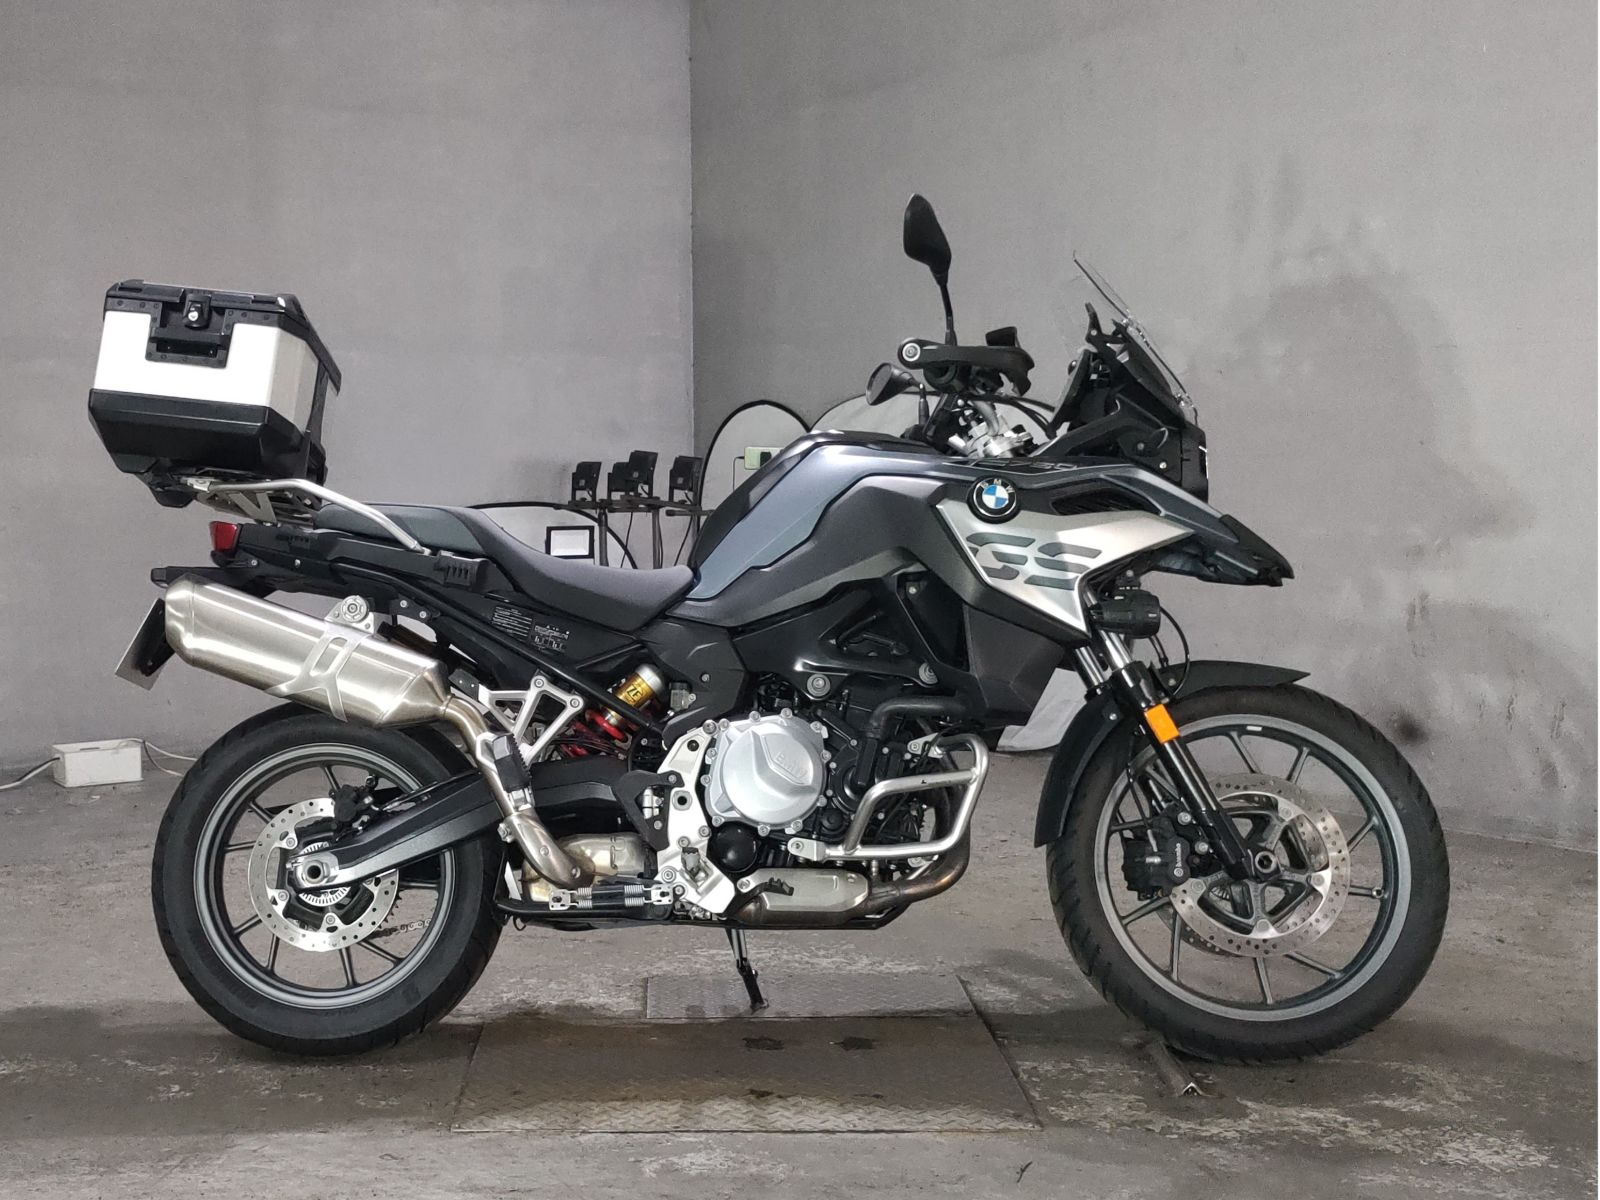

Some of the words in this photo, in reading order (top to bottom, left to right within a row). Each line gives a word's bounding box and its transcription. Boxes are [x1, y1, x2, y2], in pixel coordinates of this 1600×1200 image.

[980, 478, 1015, 493] BMW
[965, 532, 1103, 591] GS
[1174, 842, 1183, 867] brembo
